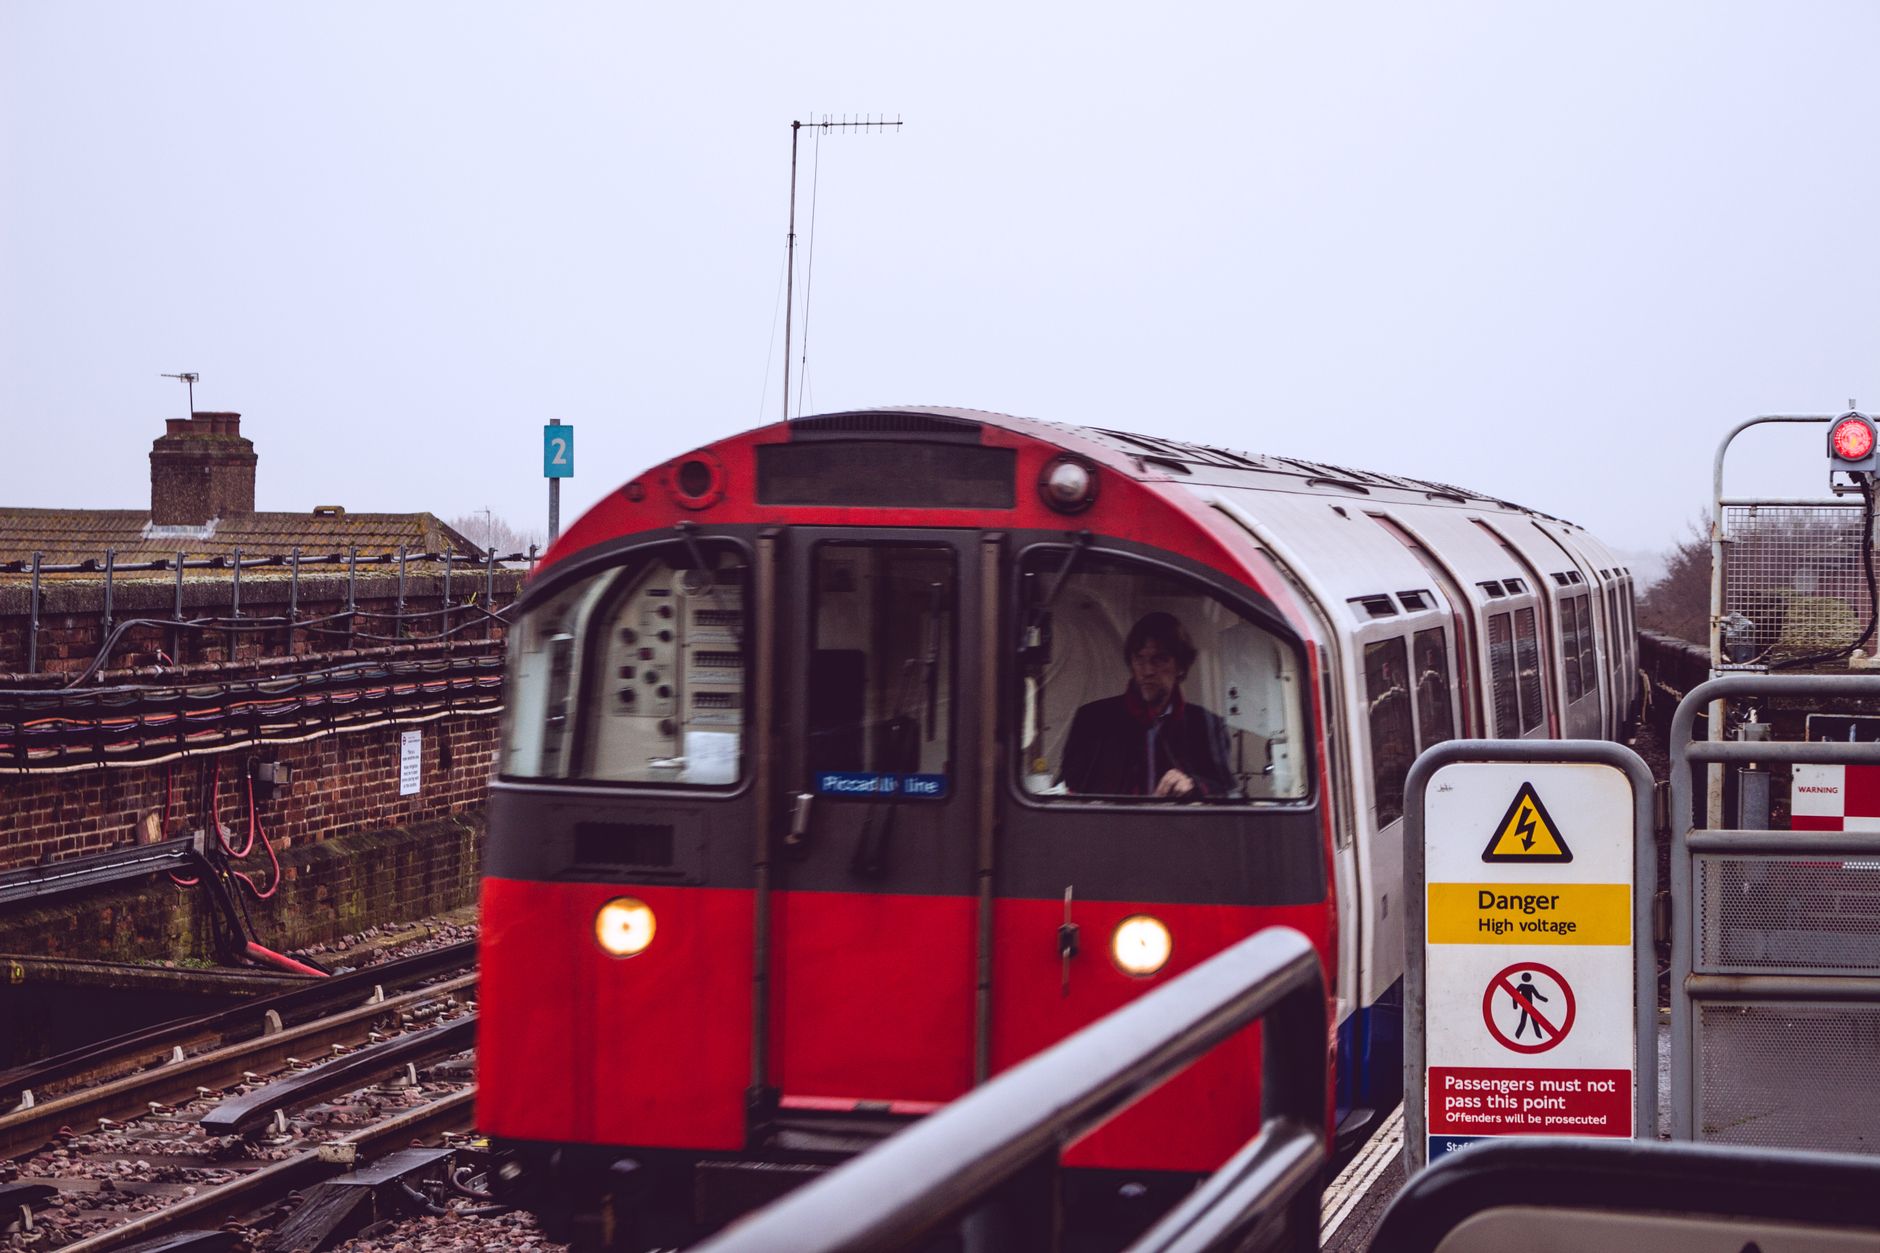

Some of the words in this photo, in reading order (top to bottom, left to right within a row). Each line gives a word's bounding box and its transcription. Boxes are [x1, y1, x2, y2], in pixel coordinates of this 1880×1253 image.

[551, 437, 567, 465] 2
[904, 777, 940, 794] line
[1798, 786, 1839, 794] WARNING
[1478, 890, 1560, 915] Danger
[1478, 918, 1514, 935] High
[1518, 918, 1577, 935] voltage
[1445, 1076, 1535, 1094] Passengers
[1540, 1079, 1582, 1092] must
[1587, 1079, 1616, 1093] not
[1445, 1096, 1482, 1110] pass
[1486, 1095, 1518, 1109] this
[1523, 1096, 1566, 1112] point
[1445, 1112, 1502, 1123] Offenders
[1504, 1114, 1525, 1124] will
[1527, 1114, 1542, 1124] be
[1545, 1115, 1607, 1126] prosecuted
